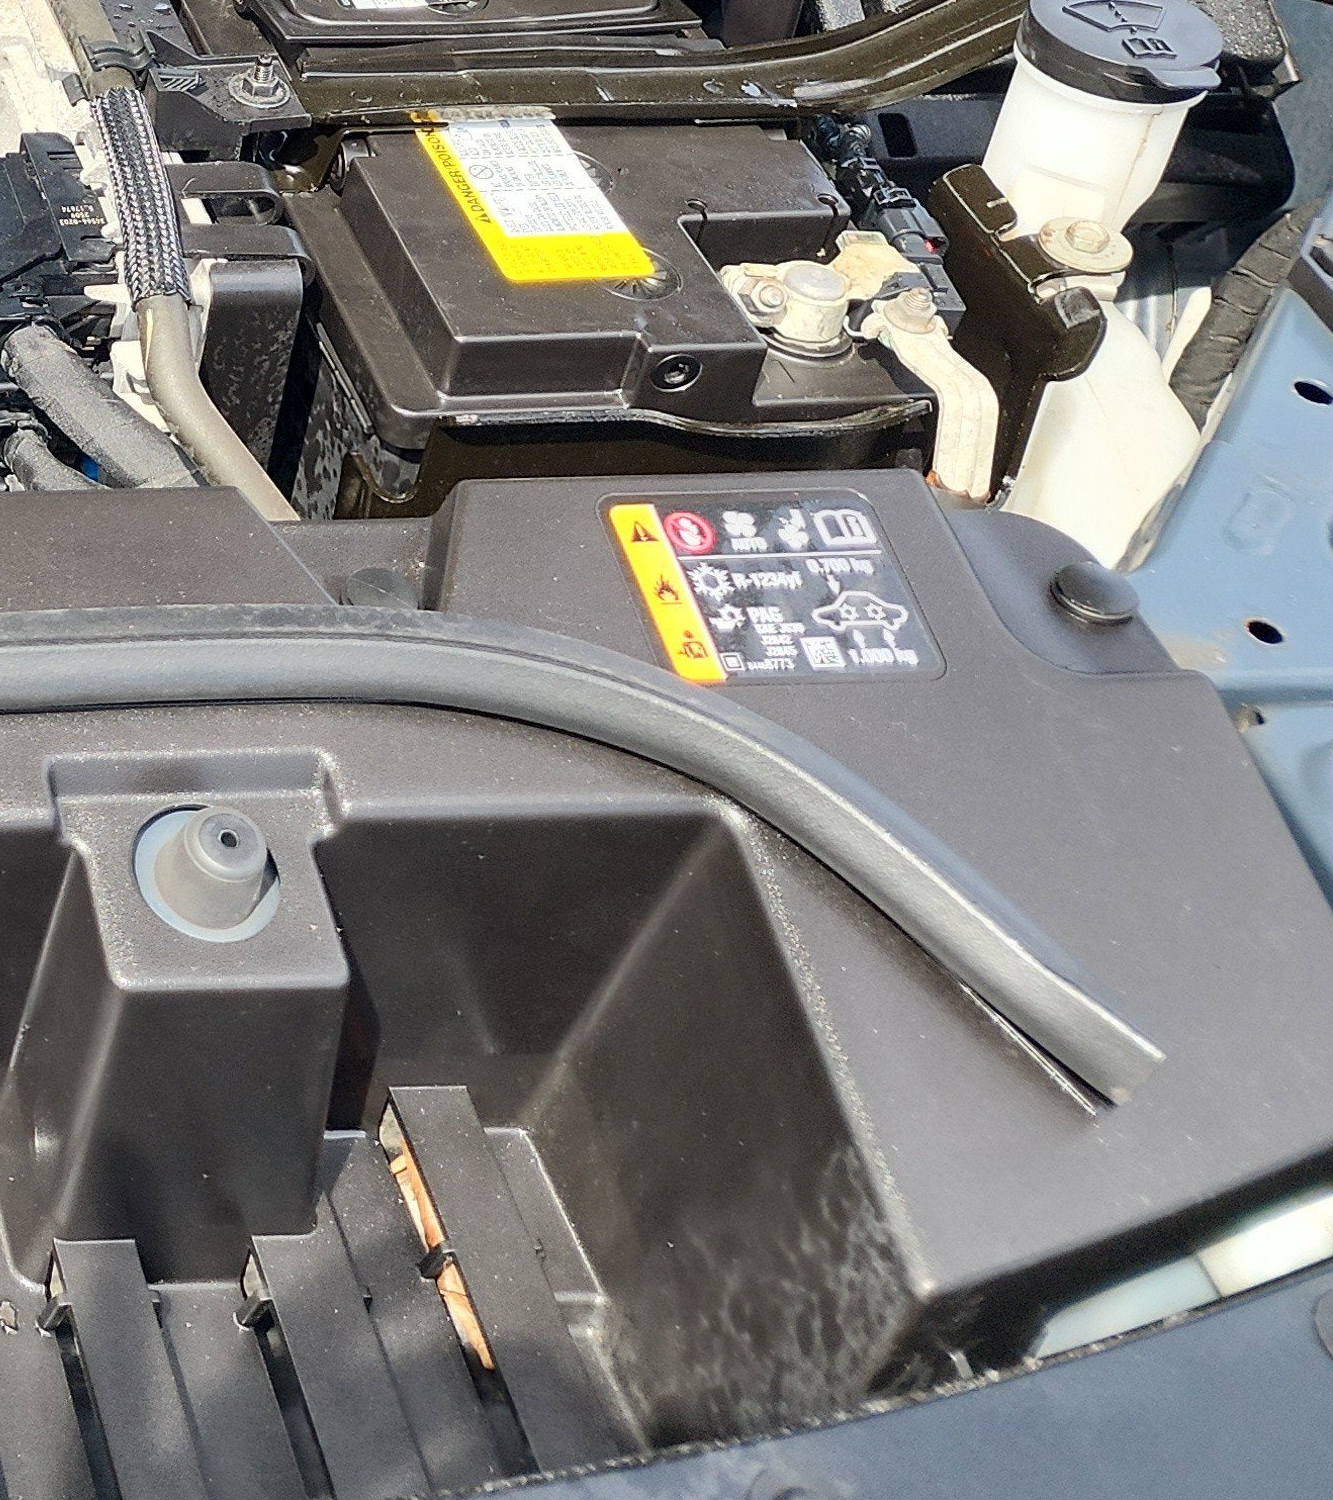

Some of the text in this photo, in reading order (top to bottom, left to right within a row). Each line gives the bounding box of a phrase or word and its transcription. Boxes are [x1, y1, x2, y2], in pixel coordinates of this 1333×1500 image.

[731, 537, 768, 550] AUTO
[733, 570, 803, 590] R-1234yf
[746, 606, 783, 623] PAG
